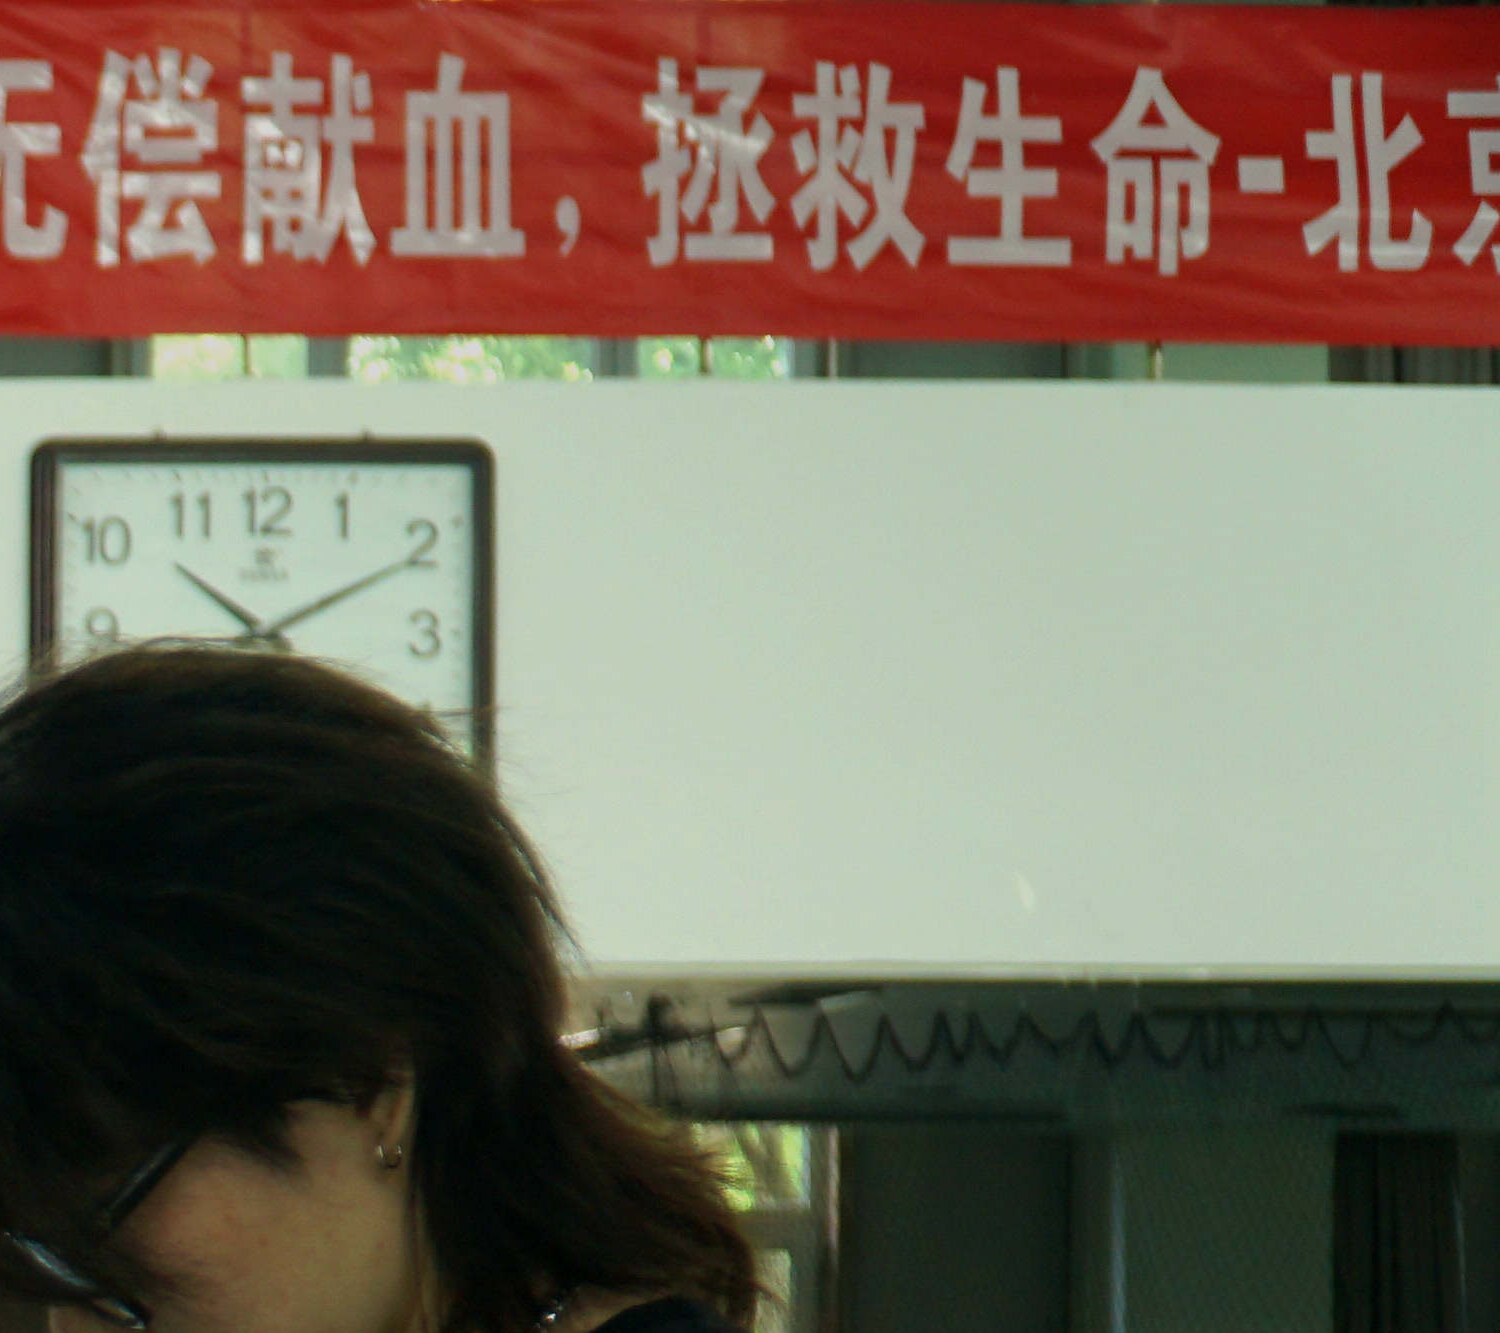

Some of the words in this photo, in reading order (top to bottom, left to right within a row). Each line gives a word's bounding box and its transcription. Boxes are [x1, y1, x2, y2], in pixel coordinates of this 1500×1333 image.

[169, 491, 213, 540] 11
[241, 486, 293, 537] 12
[334, 491, 352, 542] 1
[82, 515, 132, 566] 10
[405, 518, 439, 569] 2
[408, 608, 442, 660] 3
